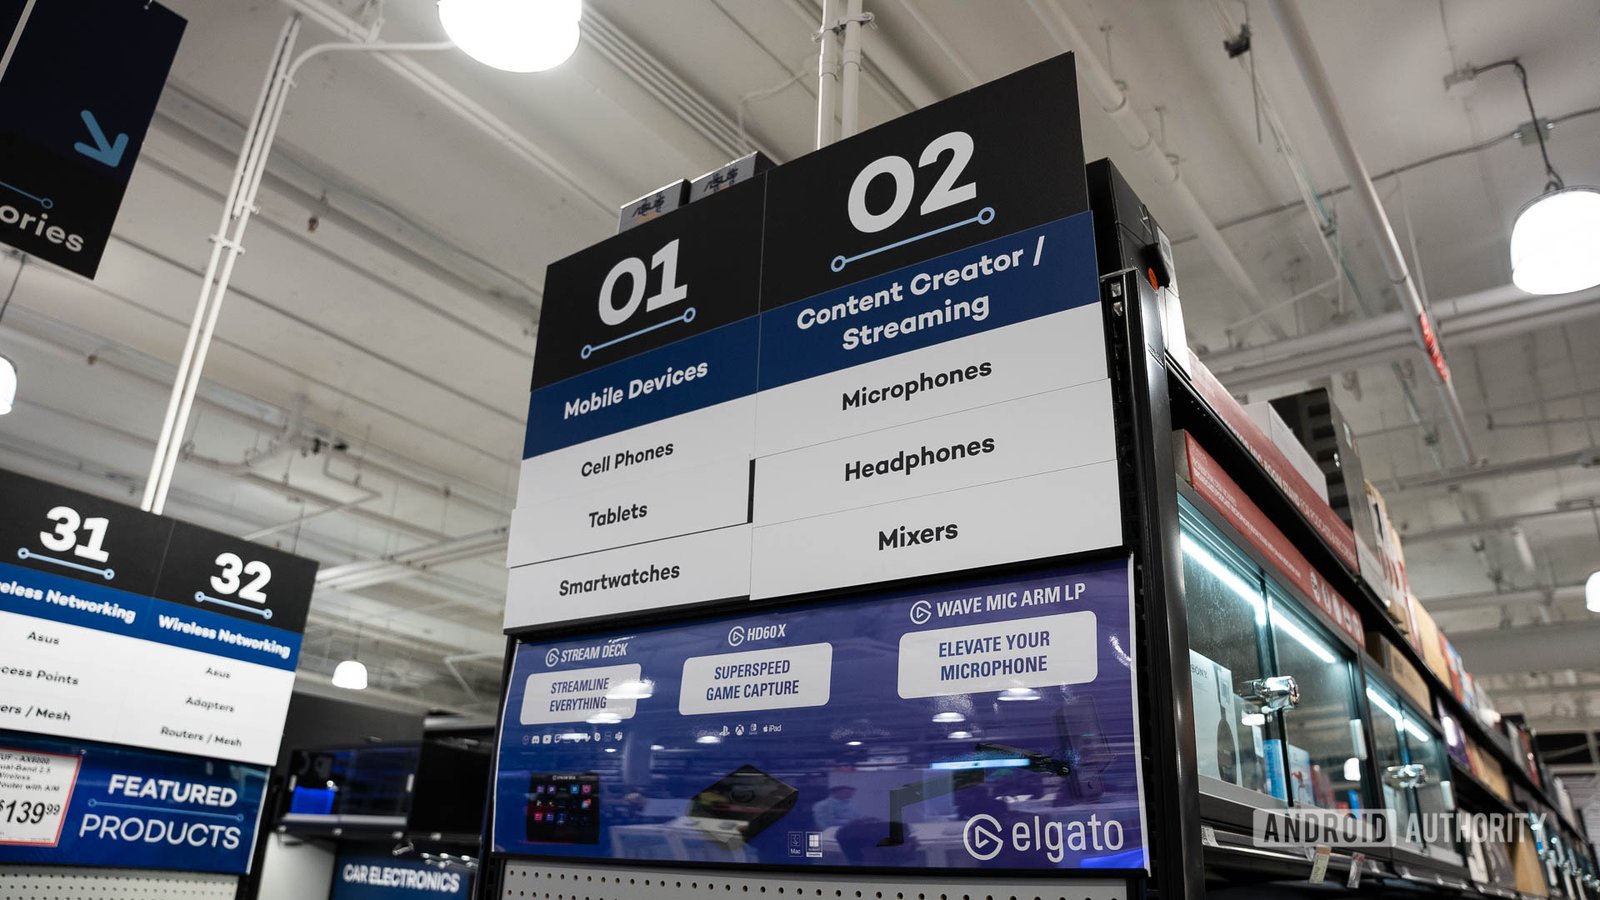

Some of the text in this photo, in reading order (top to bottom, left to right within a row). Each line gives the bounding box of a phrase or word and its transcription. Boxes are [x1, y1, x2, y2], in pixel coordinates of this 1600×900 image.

[848, 131, 976, 233] 02
[598, 239, 688, 326] 01
[797, 236, 1045, 330] Content Creator /
[842, 295, 990, 350] Streaming
[564, 362, 708, 420] Mobile Devices
[842, 361, 992, 411] Microphones
[581, 443, 674, 478] Cell Phones
[845, 436, 995, 482] Headphones
[588, 504, 647, 528] Tablets
[40, 506, 110, 563] 31
[878, 523, 958, 551] Mixers
[210, 552, 272, 604] 32
[559, 563, 680, 597] Smartwatches
[0, 580, 136, 624] eless Networking
[936, 582, 1086, 618] WAVE MIC ARM LP
[26, 632, 60, 645] Asus
[158, 614, 292, 659] Wireless Networking
[560, 642, 628, 663] STREAM DECK
[938, 630, 1050, 658] ELEVATE YOUR
[0, 666, 80, 686] cess Points
[205, 667, 231, 679] Asus
[714, 660, 790, 680] SUPERSPEED
[940, 656, 1047, 681] MICROPHONE
[551, 678, 610, 694] STREAMLINE
[706, 680, 800, 701] GAME CAPTURE
[0, 704, 71, 722] ers / Mesh
[186, 697, 235, 713] Adapters
[550, 696, 607, 712] EVERYTHING
[160, 726, 204, 741] Routers
[214, 736, 242, 748] Mesh
[108, 773, 238, 808] FEATURED
[79, 812, 242, 850] PRODUCTS
[1012, 814, 1124, 863] elgato
[342, 864, 461, 893] CAR ELECTRONICS
